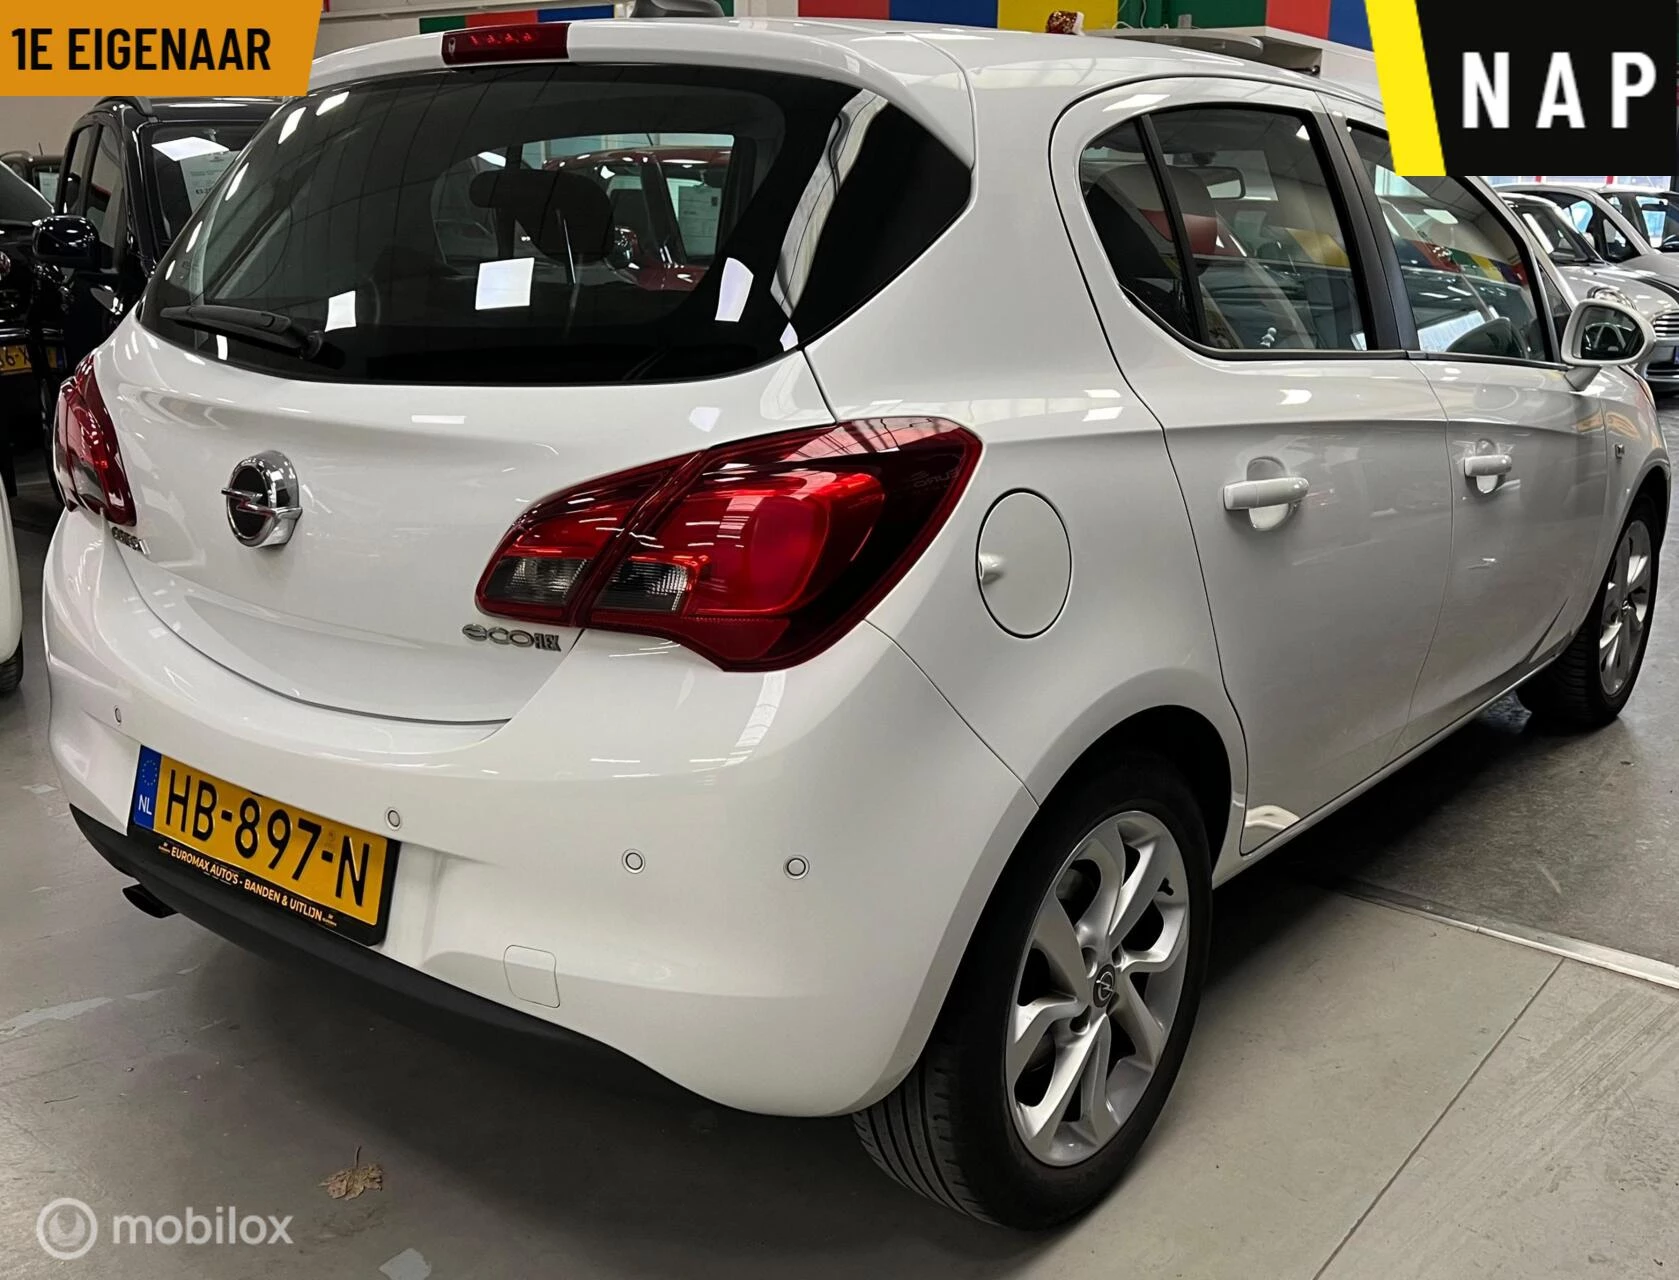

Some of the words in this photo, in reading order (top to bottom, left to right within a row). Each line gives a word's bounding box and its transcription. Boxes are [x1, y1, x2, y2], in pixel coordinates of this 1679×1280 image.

[138, 794, 152, 815] NL
[166, 769, 370, 907] HB-897-N
[171, 846, 210, 872] EUROMAX
[210, 864, 239, 885] AUTO'S
[244, 879, 281, 903] BANDEN
[281, 895, 288, 906] &
[290, 898, 323, 922] UITLIJN
